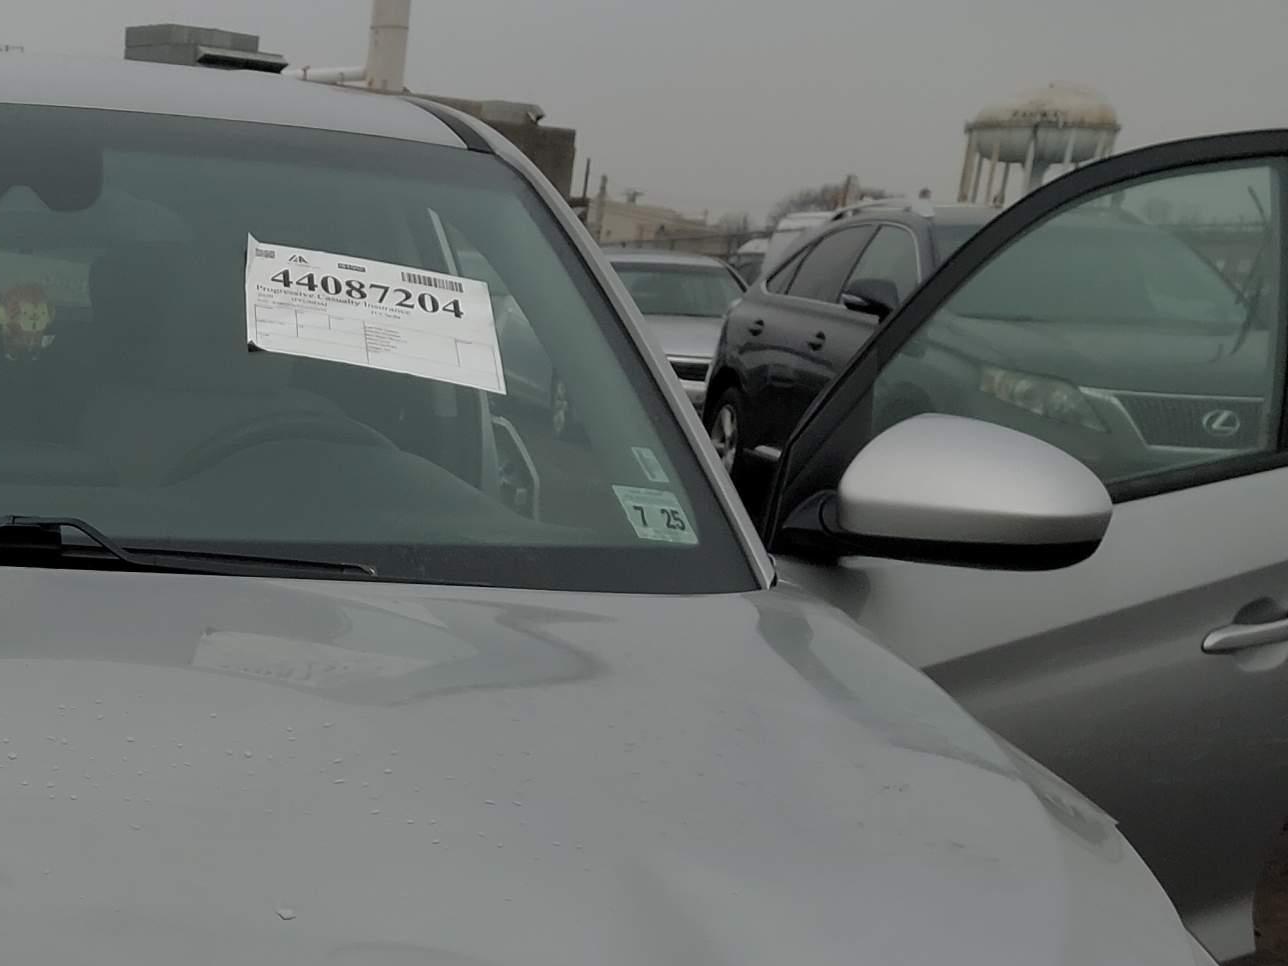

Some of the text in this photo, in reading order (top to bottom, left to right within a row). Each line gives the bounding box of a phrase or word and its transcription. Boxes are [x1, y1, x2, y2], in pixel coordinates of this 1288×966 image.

[256, 284, 315, 299] Progressive
[317, 293, 360, 307] Casualty
[364, 300, 411, 315] Insurance
[270, 269, 464, 319] 44087204
[633, 505, 686, 531] 7 25
